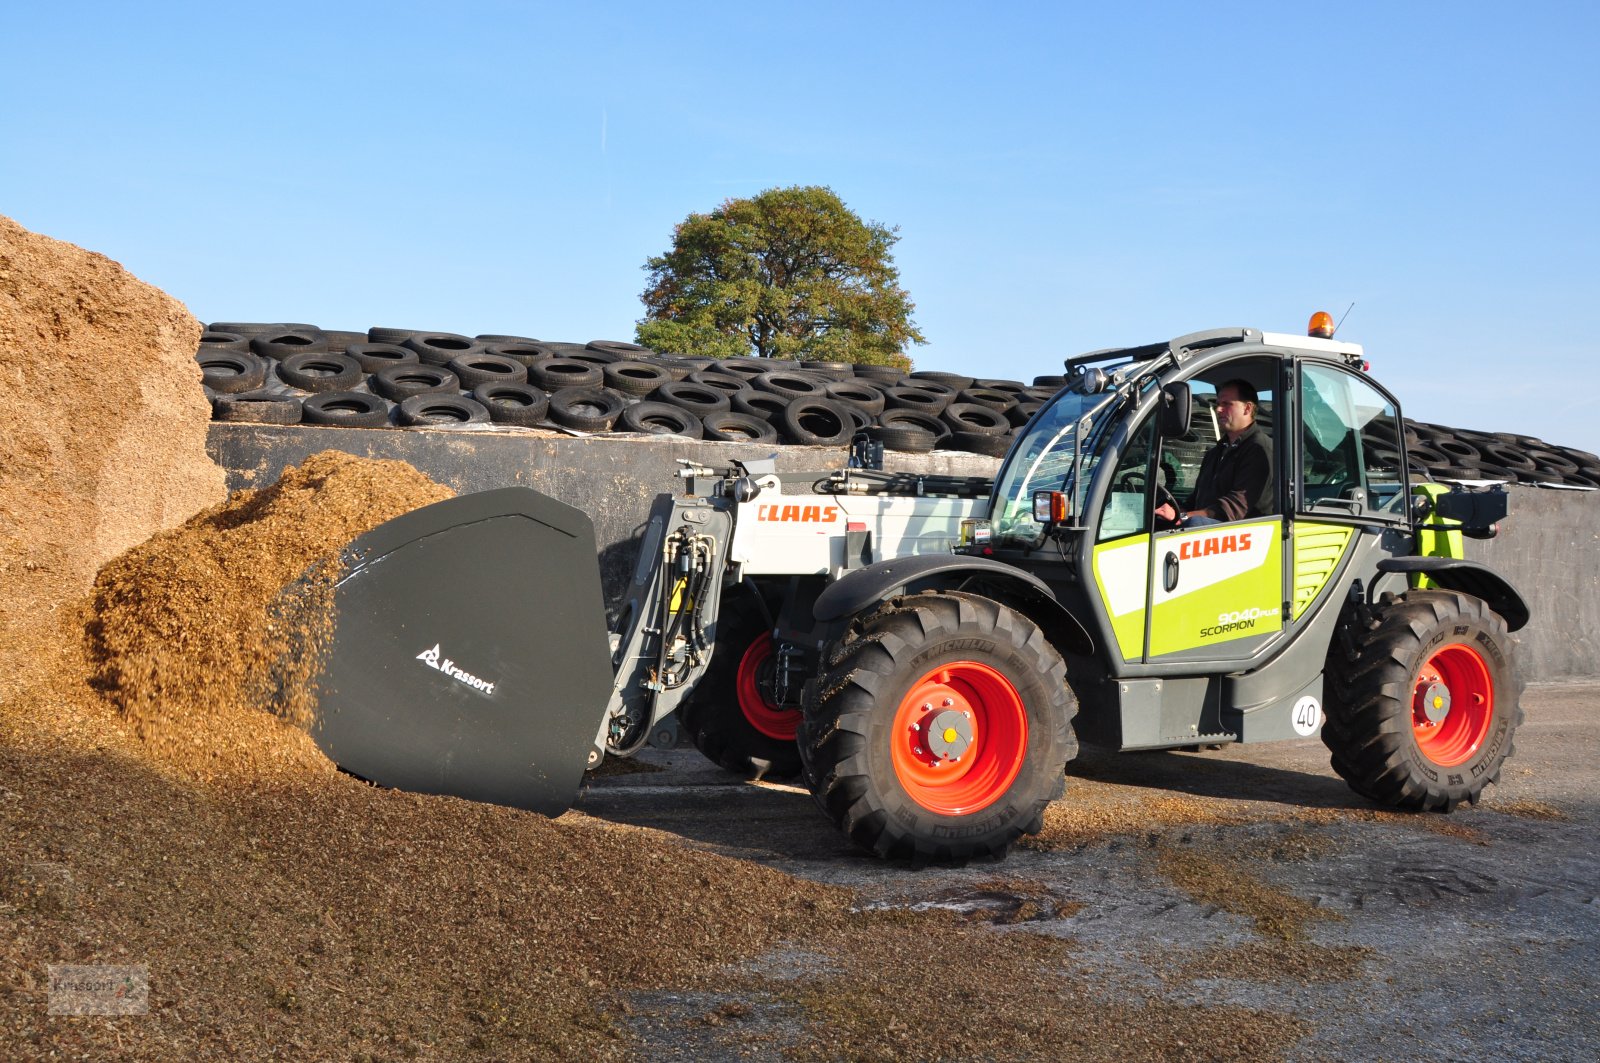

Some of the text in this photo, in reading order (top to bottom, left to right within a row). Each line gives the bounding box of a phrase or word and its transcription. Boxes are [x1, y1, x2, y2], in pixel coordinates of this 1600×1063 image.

[758, 505, 838, 522] CLAAS
[1180, 533, 1251, 560] CLAAS
[1200, 619, 1255, 637] SCORPION
[928, 640, 995, 658] MICHELIN
[440, 659, 495, 694] Krassort
[1297, 704, 1315, 727] 40
